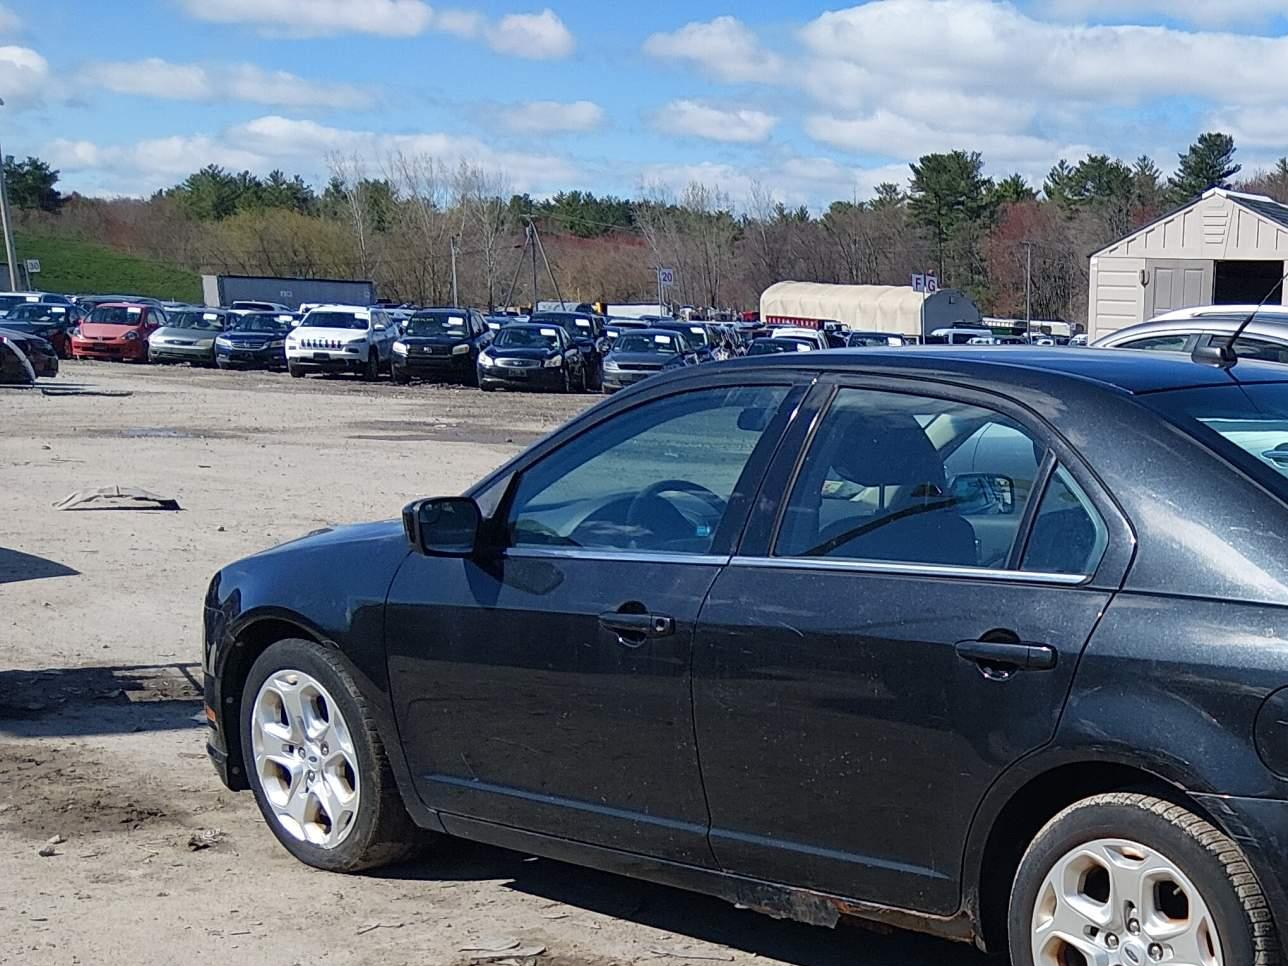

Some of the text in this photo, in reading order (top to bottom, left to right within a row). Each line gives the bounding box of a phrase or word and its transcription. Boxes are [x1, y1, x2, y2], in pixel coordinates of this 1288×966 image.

[662, 271, 673, 282] 20
[915, 277, 921, 289] F
[928, 279, 936, 291] G
